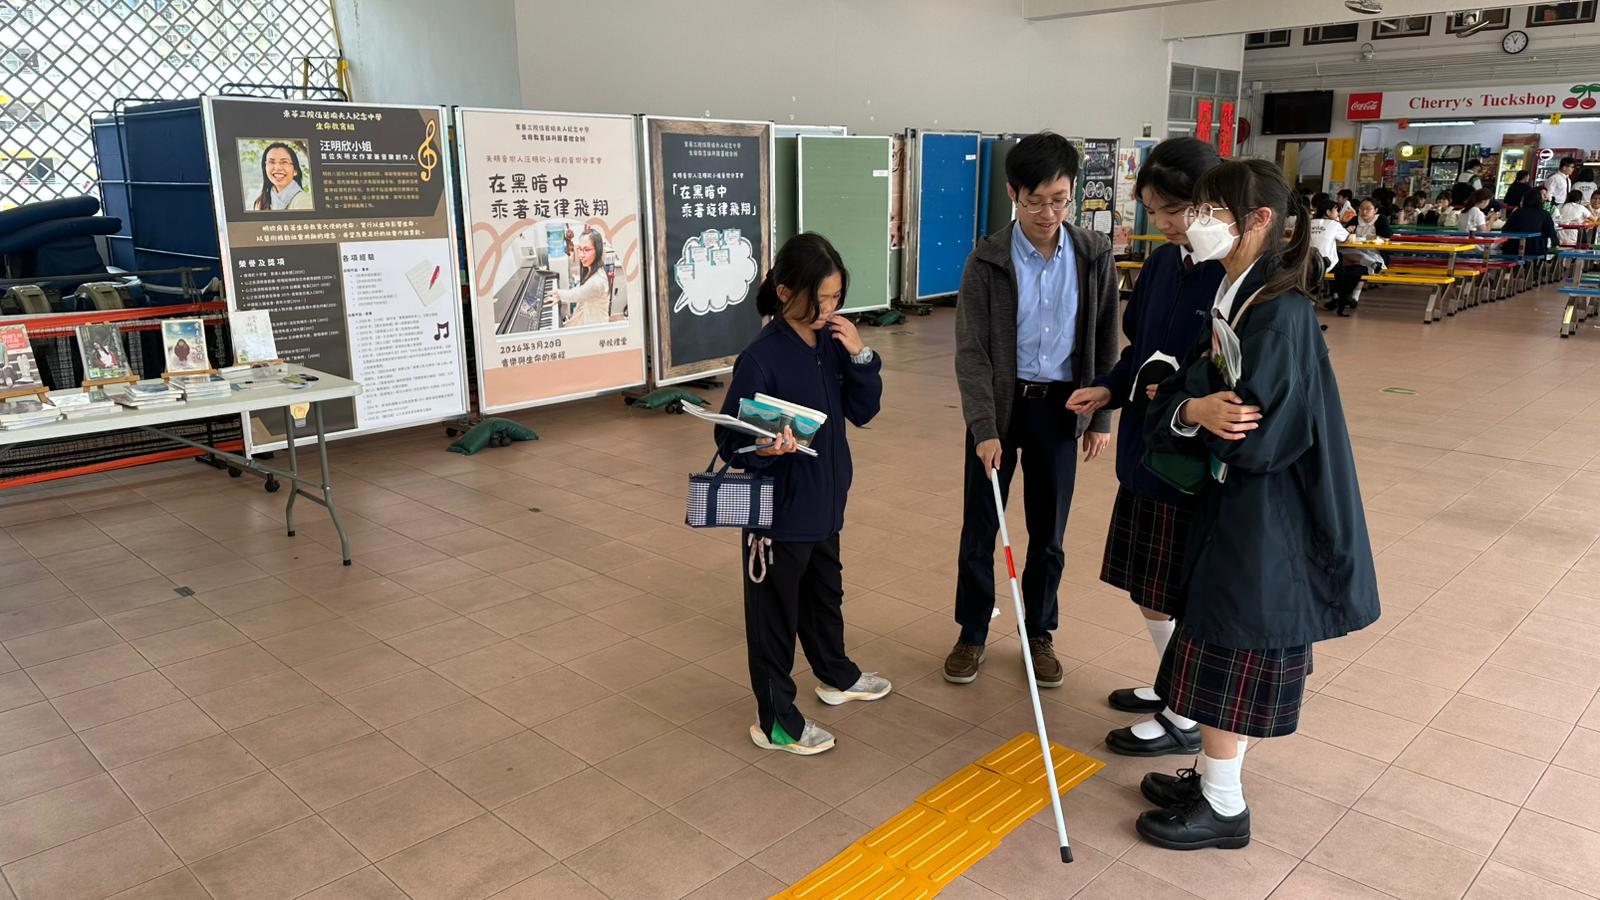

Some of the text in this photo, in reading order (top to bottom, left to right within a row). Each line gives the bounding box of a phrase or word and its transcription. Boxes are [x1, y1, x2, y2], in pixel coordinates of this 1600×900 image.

[1350, 99, 1379, 111] Coca-Cola
[1408, 92, 1556, 111] Cherry's Tuckshop
[319, 139, 373, 152] 汪明欣小姐
[488, 173, 569, 194] 在黑暗中
[672, 183, 727, 200] 「在黑暗中
[490, 198, 609, 219] 乘著旋律飛翔
[681, 201, 757, 218] 乘著旋律飛翔」
[238, 257, 286, 268] 榮譽及獎項
[343, 253, 375, 262] 各項經驗
[500, 339, 562, 354] 2026年3月20日
[501, 351, 566, 367] 音樂與生命的旅程
